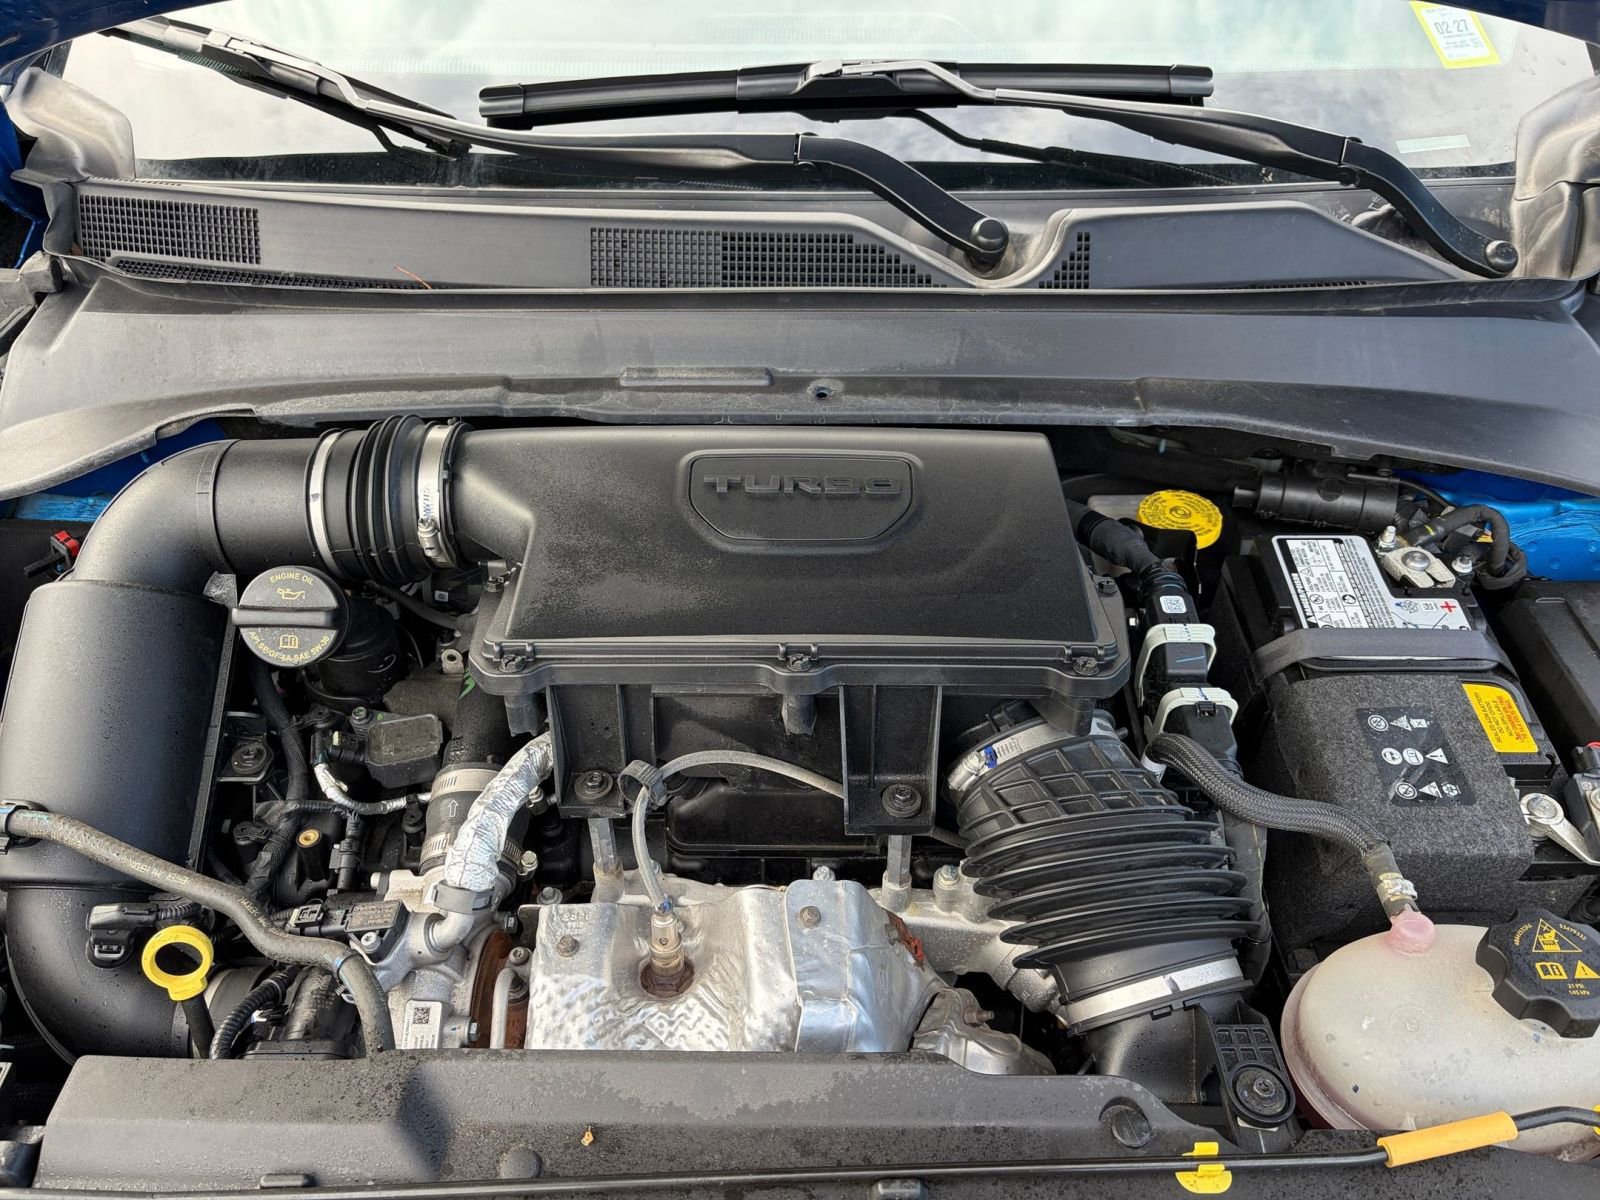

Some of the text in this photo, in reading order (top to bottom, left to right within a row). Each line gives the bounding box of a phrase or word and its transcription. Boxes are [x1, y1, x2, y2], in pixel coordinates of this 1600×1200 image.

[1434, 19, 1469, 34] 02 27
[703, 474, 902, 495] TURBO
[269, 571, 314, 586] ENGINE OIL
[310, 635, 330, 656] 5W-30
